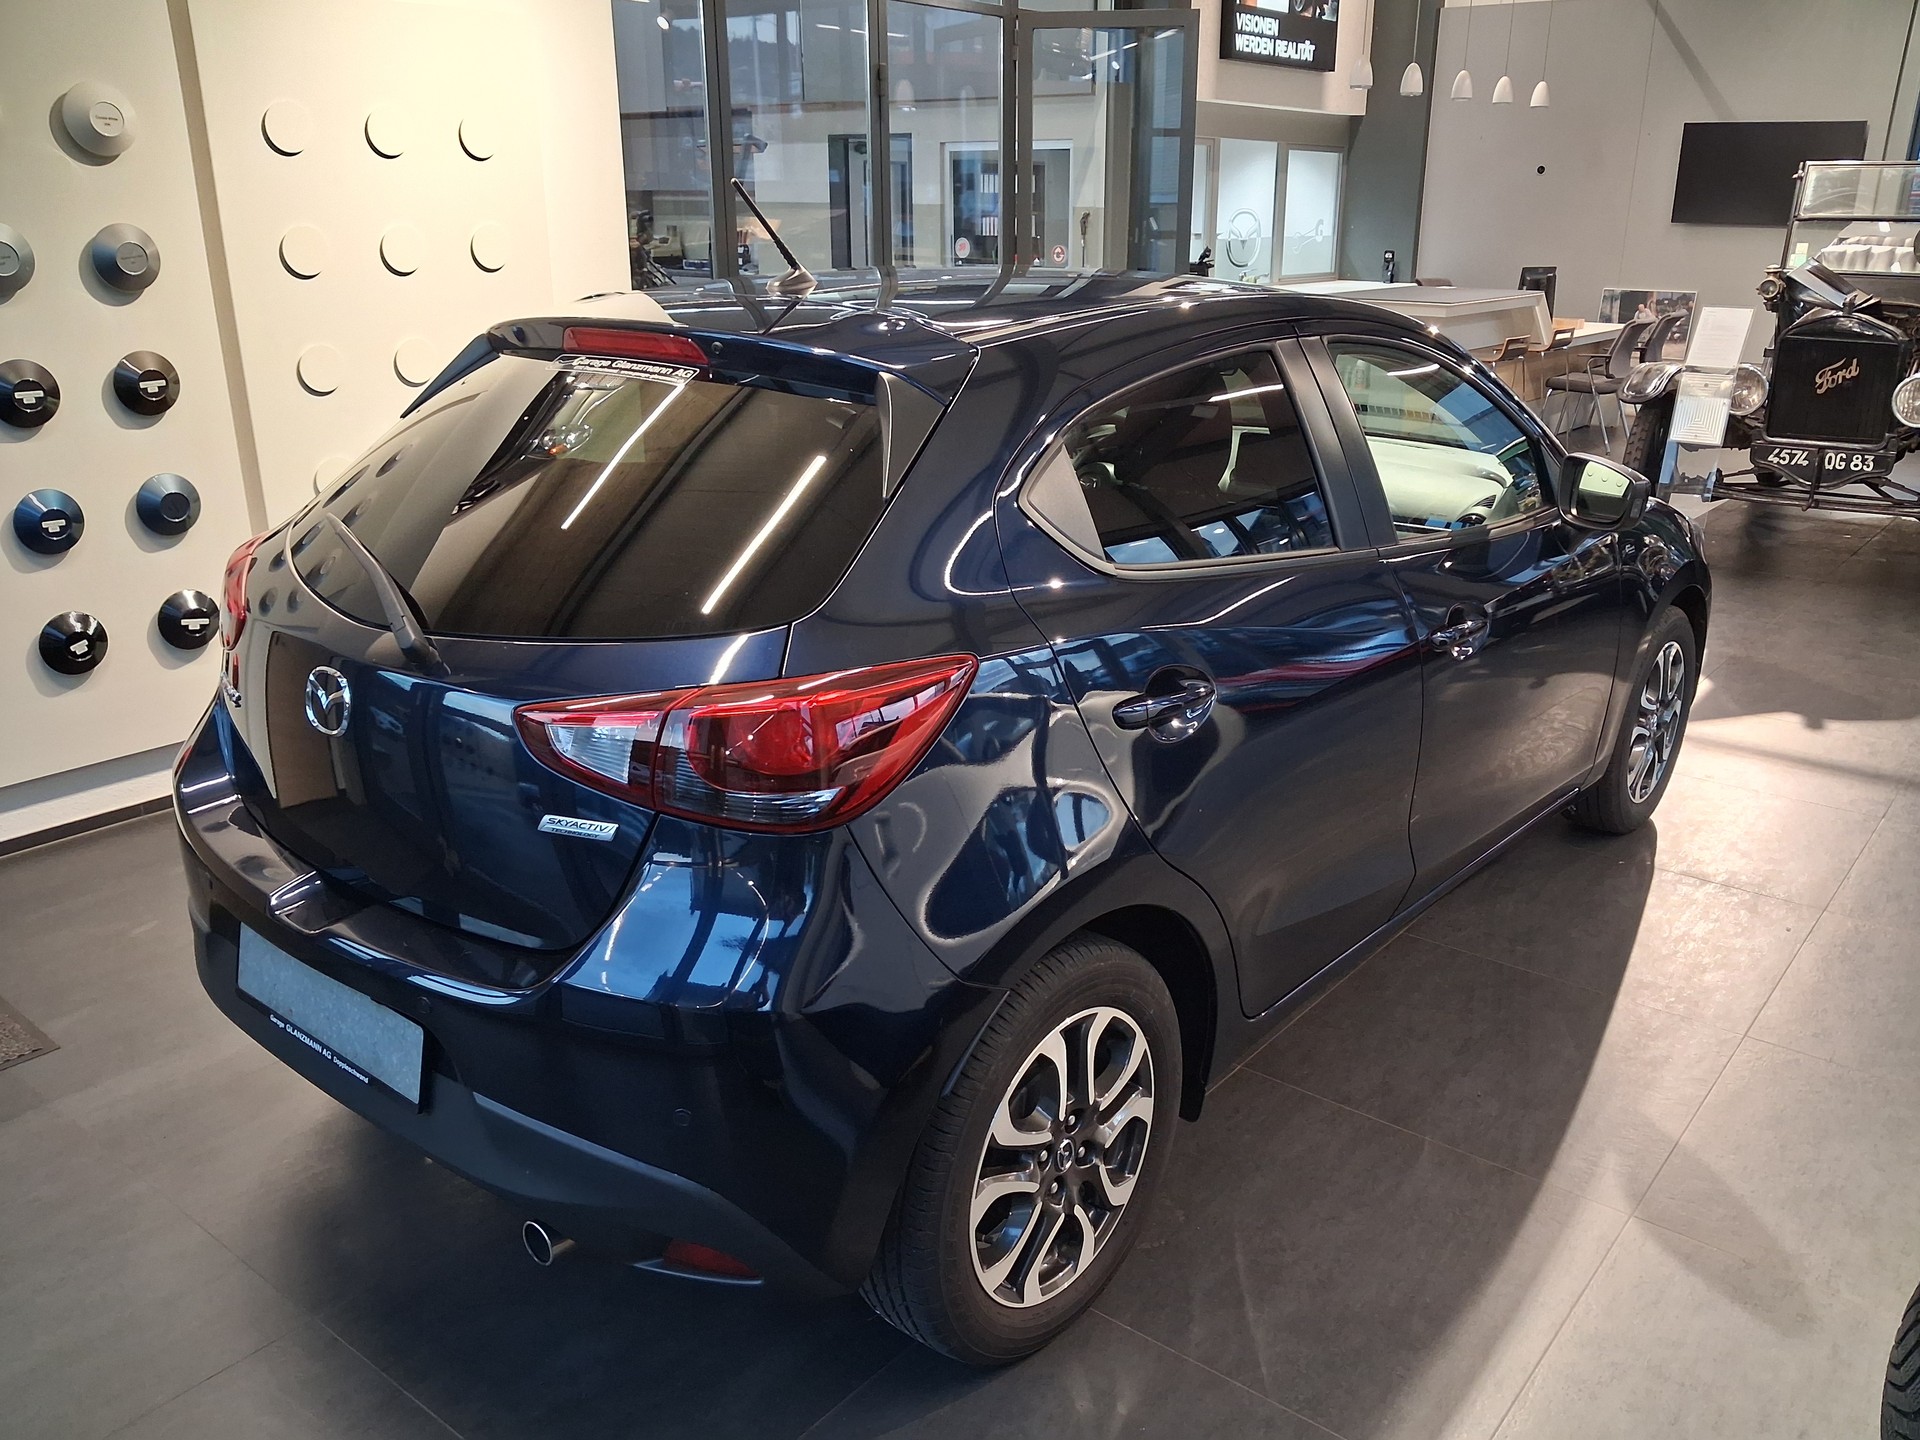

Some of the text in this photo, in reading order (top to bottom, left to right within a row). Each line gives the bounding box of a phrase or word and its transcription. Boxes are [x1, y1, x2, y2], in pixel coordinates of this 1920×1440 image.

[1236, 12, 1279, 36] VISIONEN
[1235, 33, 1316, 61] WERDEN REALITÄT
[572, 356, 611, 369] Garage
[612, 360, 672, 375] Glanzmann
[673, 369, 694, 378] AG
[1815, 358, 1860, 394] Ford
[1767, 448, 1809, 466] 4574
[1850, 454, 1875, 471] 83
[546, 817, 609, 832] SKYACTIV
[551, 827, 600, 838] TECHNOLOGY
[285, 1024, 322, 1053] GLANZMANN
[322, 1048, 332, 1060] AG
